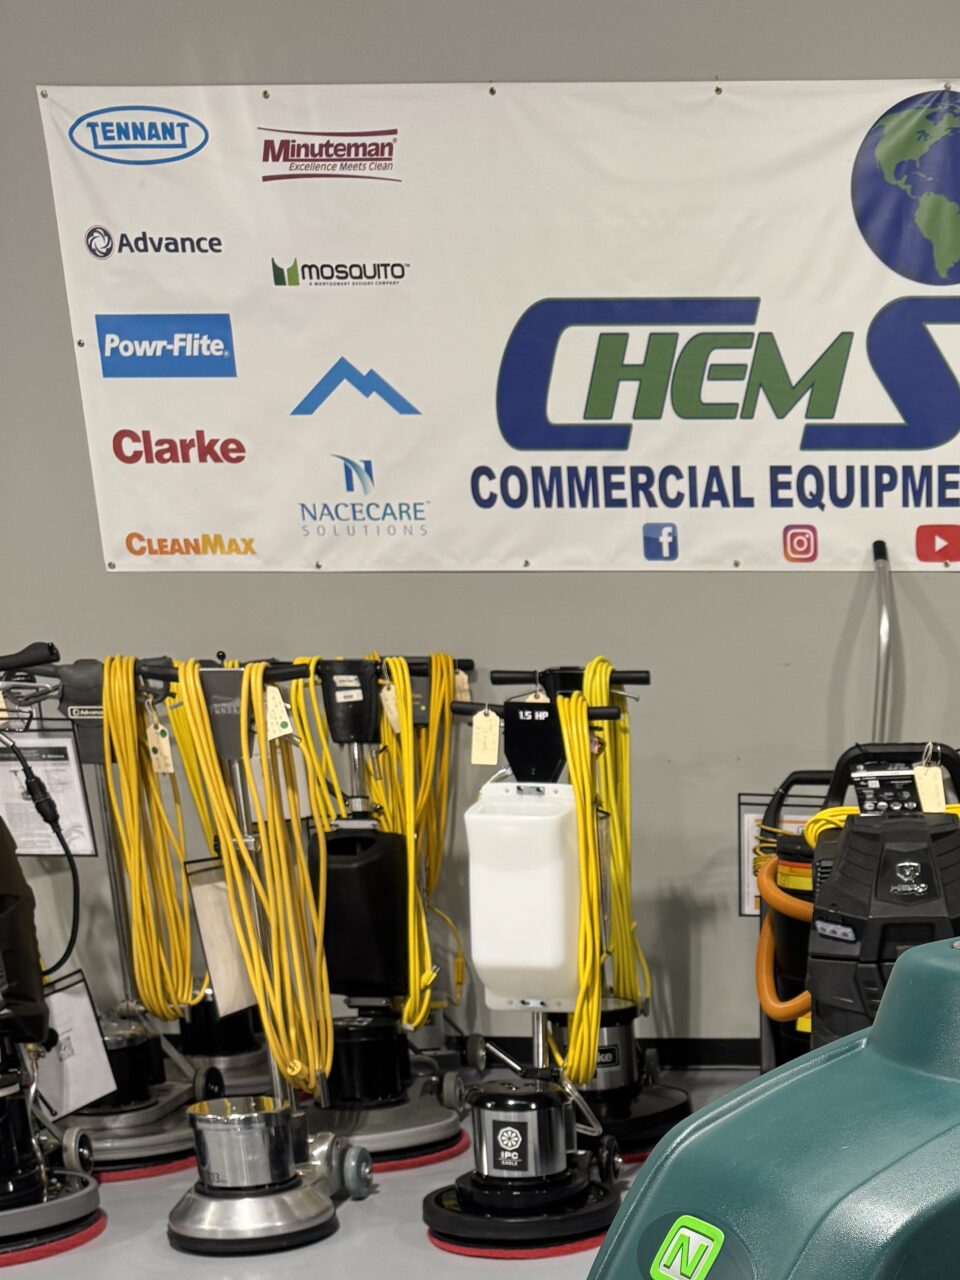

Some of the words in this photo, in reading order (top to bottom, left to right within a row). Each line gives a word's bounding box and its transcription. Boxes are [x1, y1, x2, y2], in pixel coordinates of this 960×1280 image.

[86, 121, 189, 149] TENNANT
[262, 139, 393, 162] Minuteman
[288, 161, 337, 172] Excellence
[339, 161, 366, 172] Meets
[368, 161, 394, 171] Clean
[117, 231, 223, 254] Advance
[104, 332, 225, 358] Powr-Flite
[112, 428, 247, 465] Clarke
[470, 464, 755, 510] COMMERCIAL
[299, 502, 426, 522] NACECARE
[301, 524, 428, 537] SOLUTIONS
[535, 711, 549, 720] HP
[500, 1151, 519, 1160] IPC
